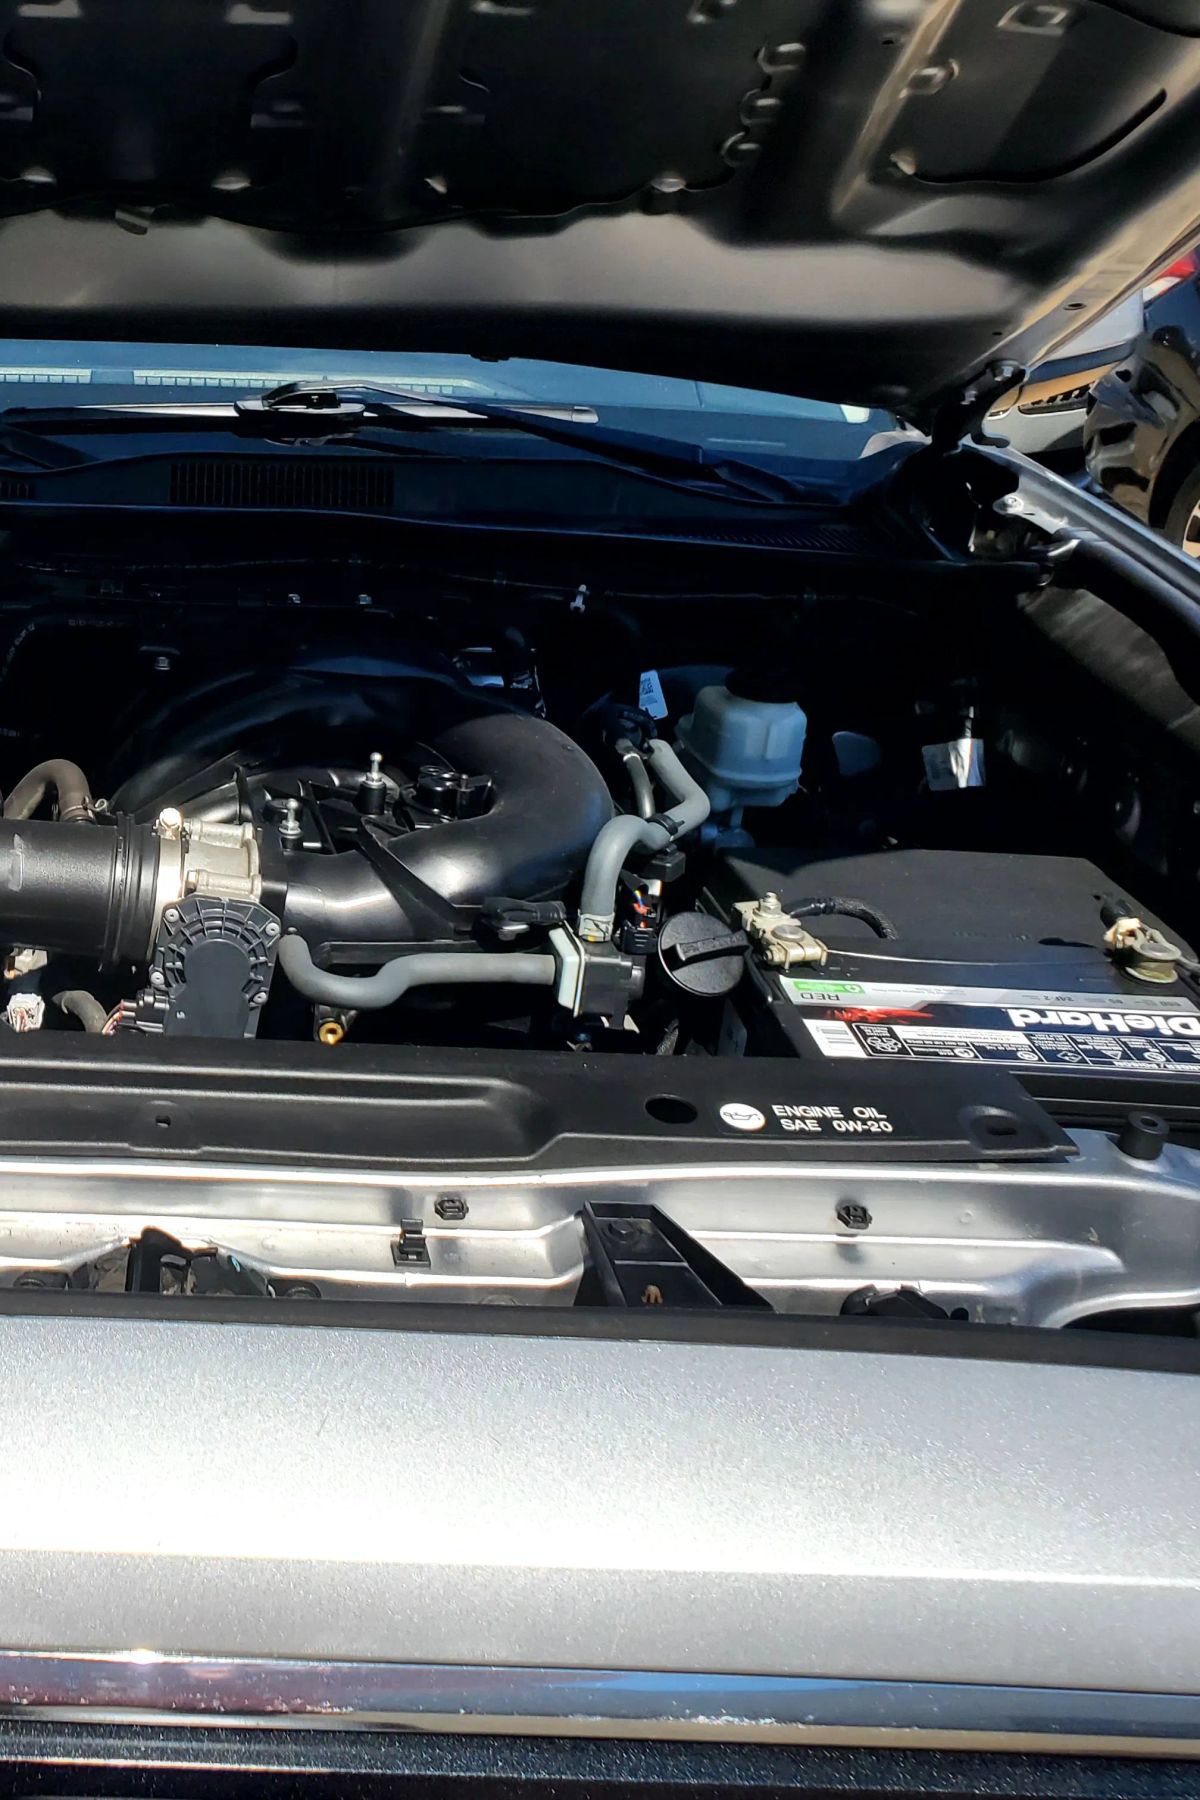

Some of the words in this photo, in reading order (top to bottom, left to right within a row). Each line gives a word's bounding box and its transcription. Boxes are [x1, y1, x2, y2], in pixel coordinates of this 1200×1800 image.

[800, 992, 840, 1001] RED
[1008, 1008, 1200, 1036] DieHard
[771, 1104, 844, 1118] ENGINE
[853, 1106, 887, 1119] OIL
[780, 1118, 822, 1131] SAE
[832, 1119, 893, 1132] 0W-20
